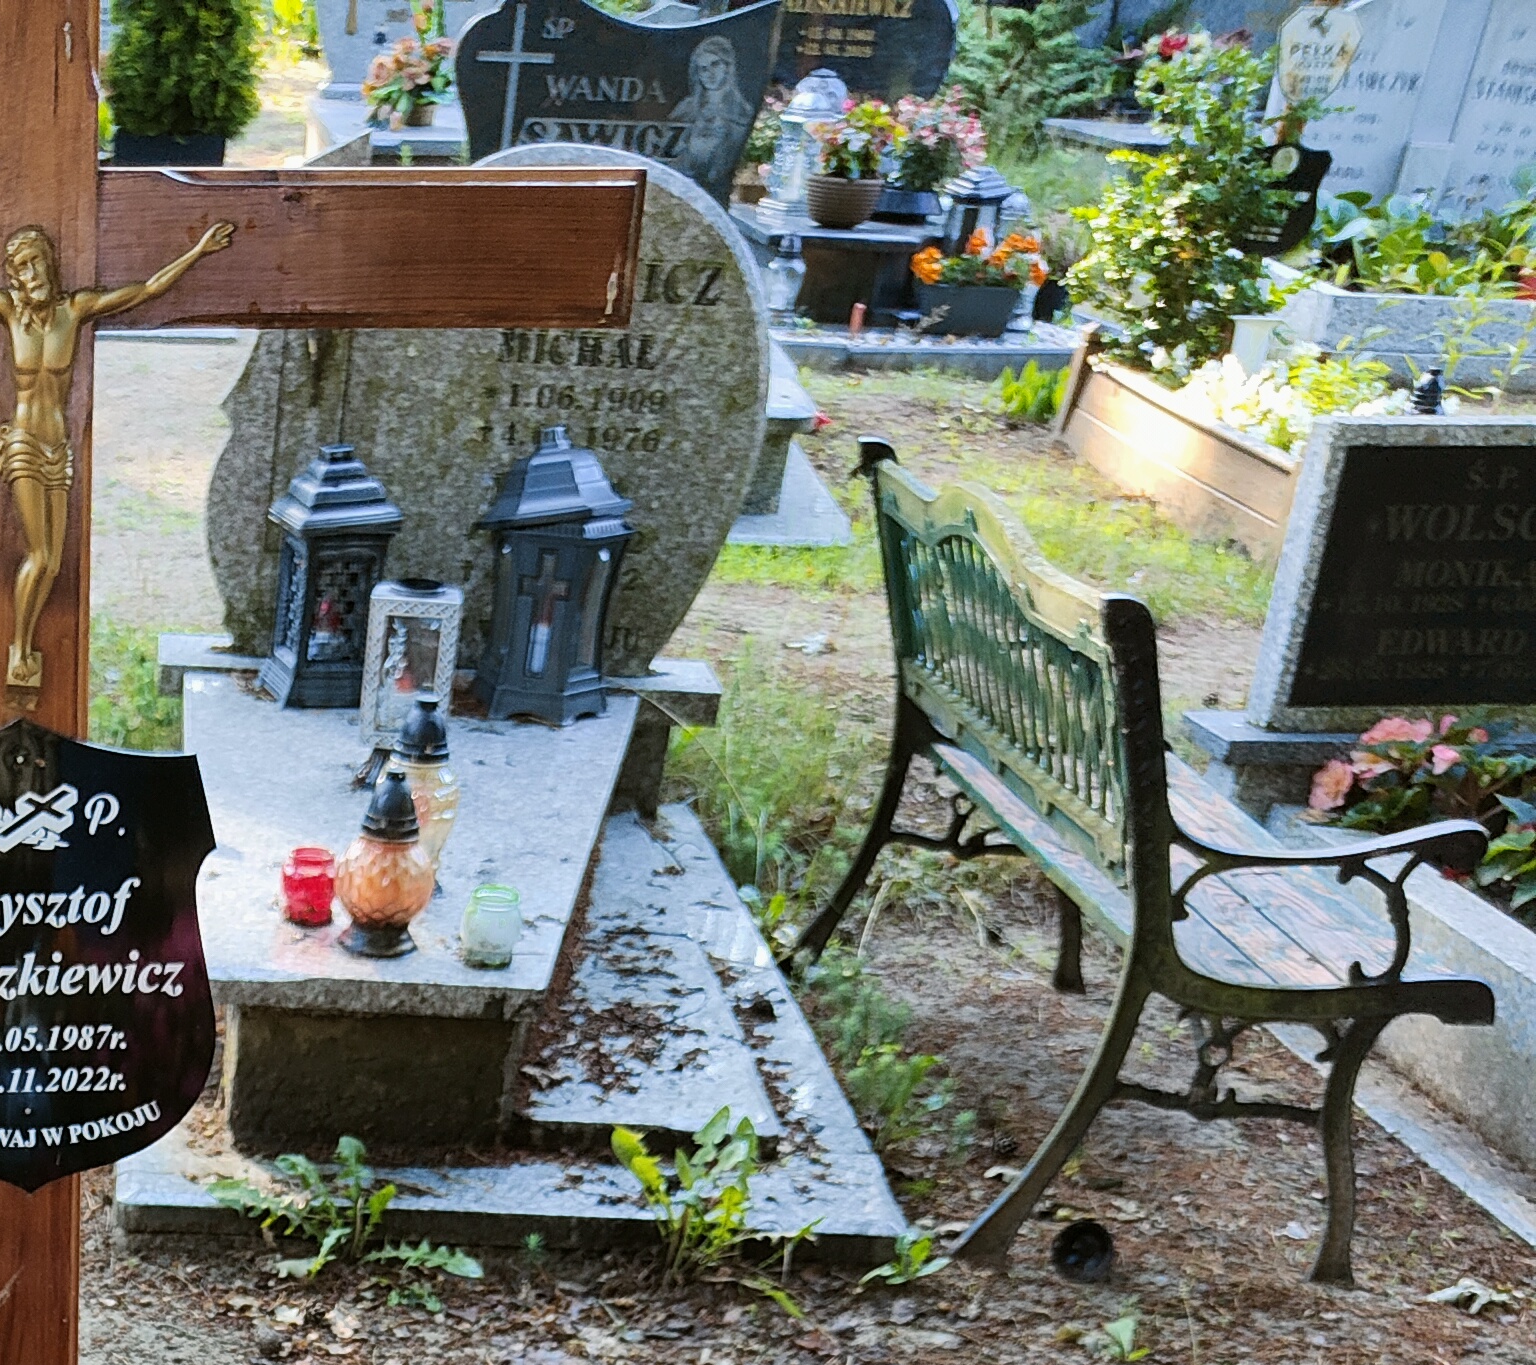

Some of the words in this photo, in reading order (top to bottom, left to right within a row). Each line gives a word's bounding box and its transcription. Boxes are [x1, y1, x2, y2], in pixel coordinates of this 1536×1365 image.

[545, 75, 667, 104] WANDA
[40, 1126, 65, 1147] W
[67, 1100, 163, 1145] POKOJU
